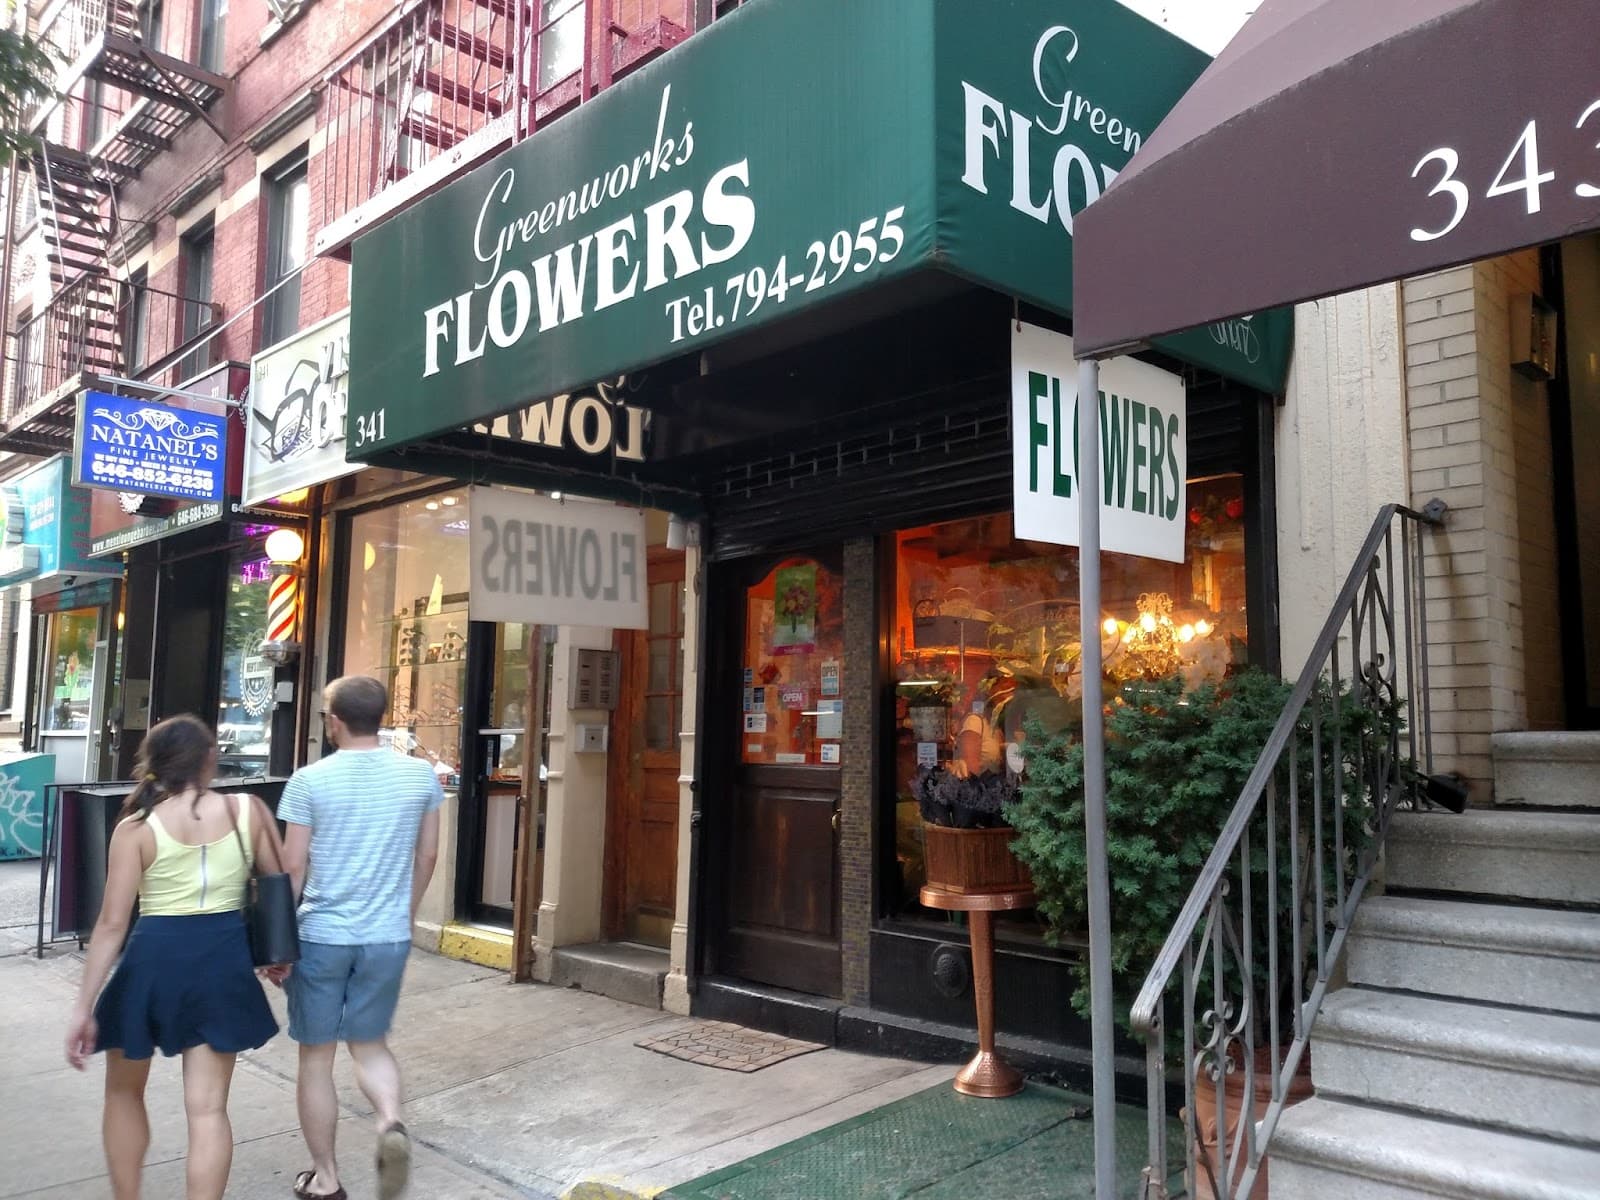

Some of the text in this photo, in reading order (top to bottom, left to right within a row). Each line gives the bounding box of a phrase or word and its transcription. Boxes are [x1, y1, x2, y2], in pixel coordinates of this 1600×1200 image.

[473, 83, 695, 290] Greenworks
[961, 80, 1120, 237] FLO
[422, 157, 757, 378] FLOWERS
[91, 423, 218, 461] NATANEL'S
[110, 446, 139, 458] FINE
[144, 452, 198, 467] JEWELRY
[354, 407, 387, 448] 341
[1028, 370, 1180, 522] FLWERS
